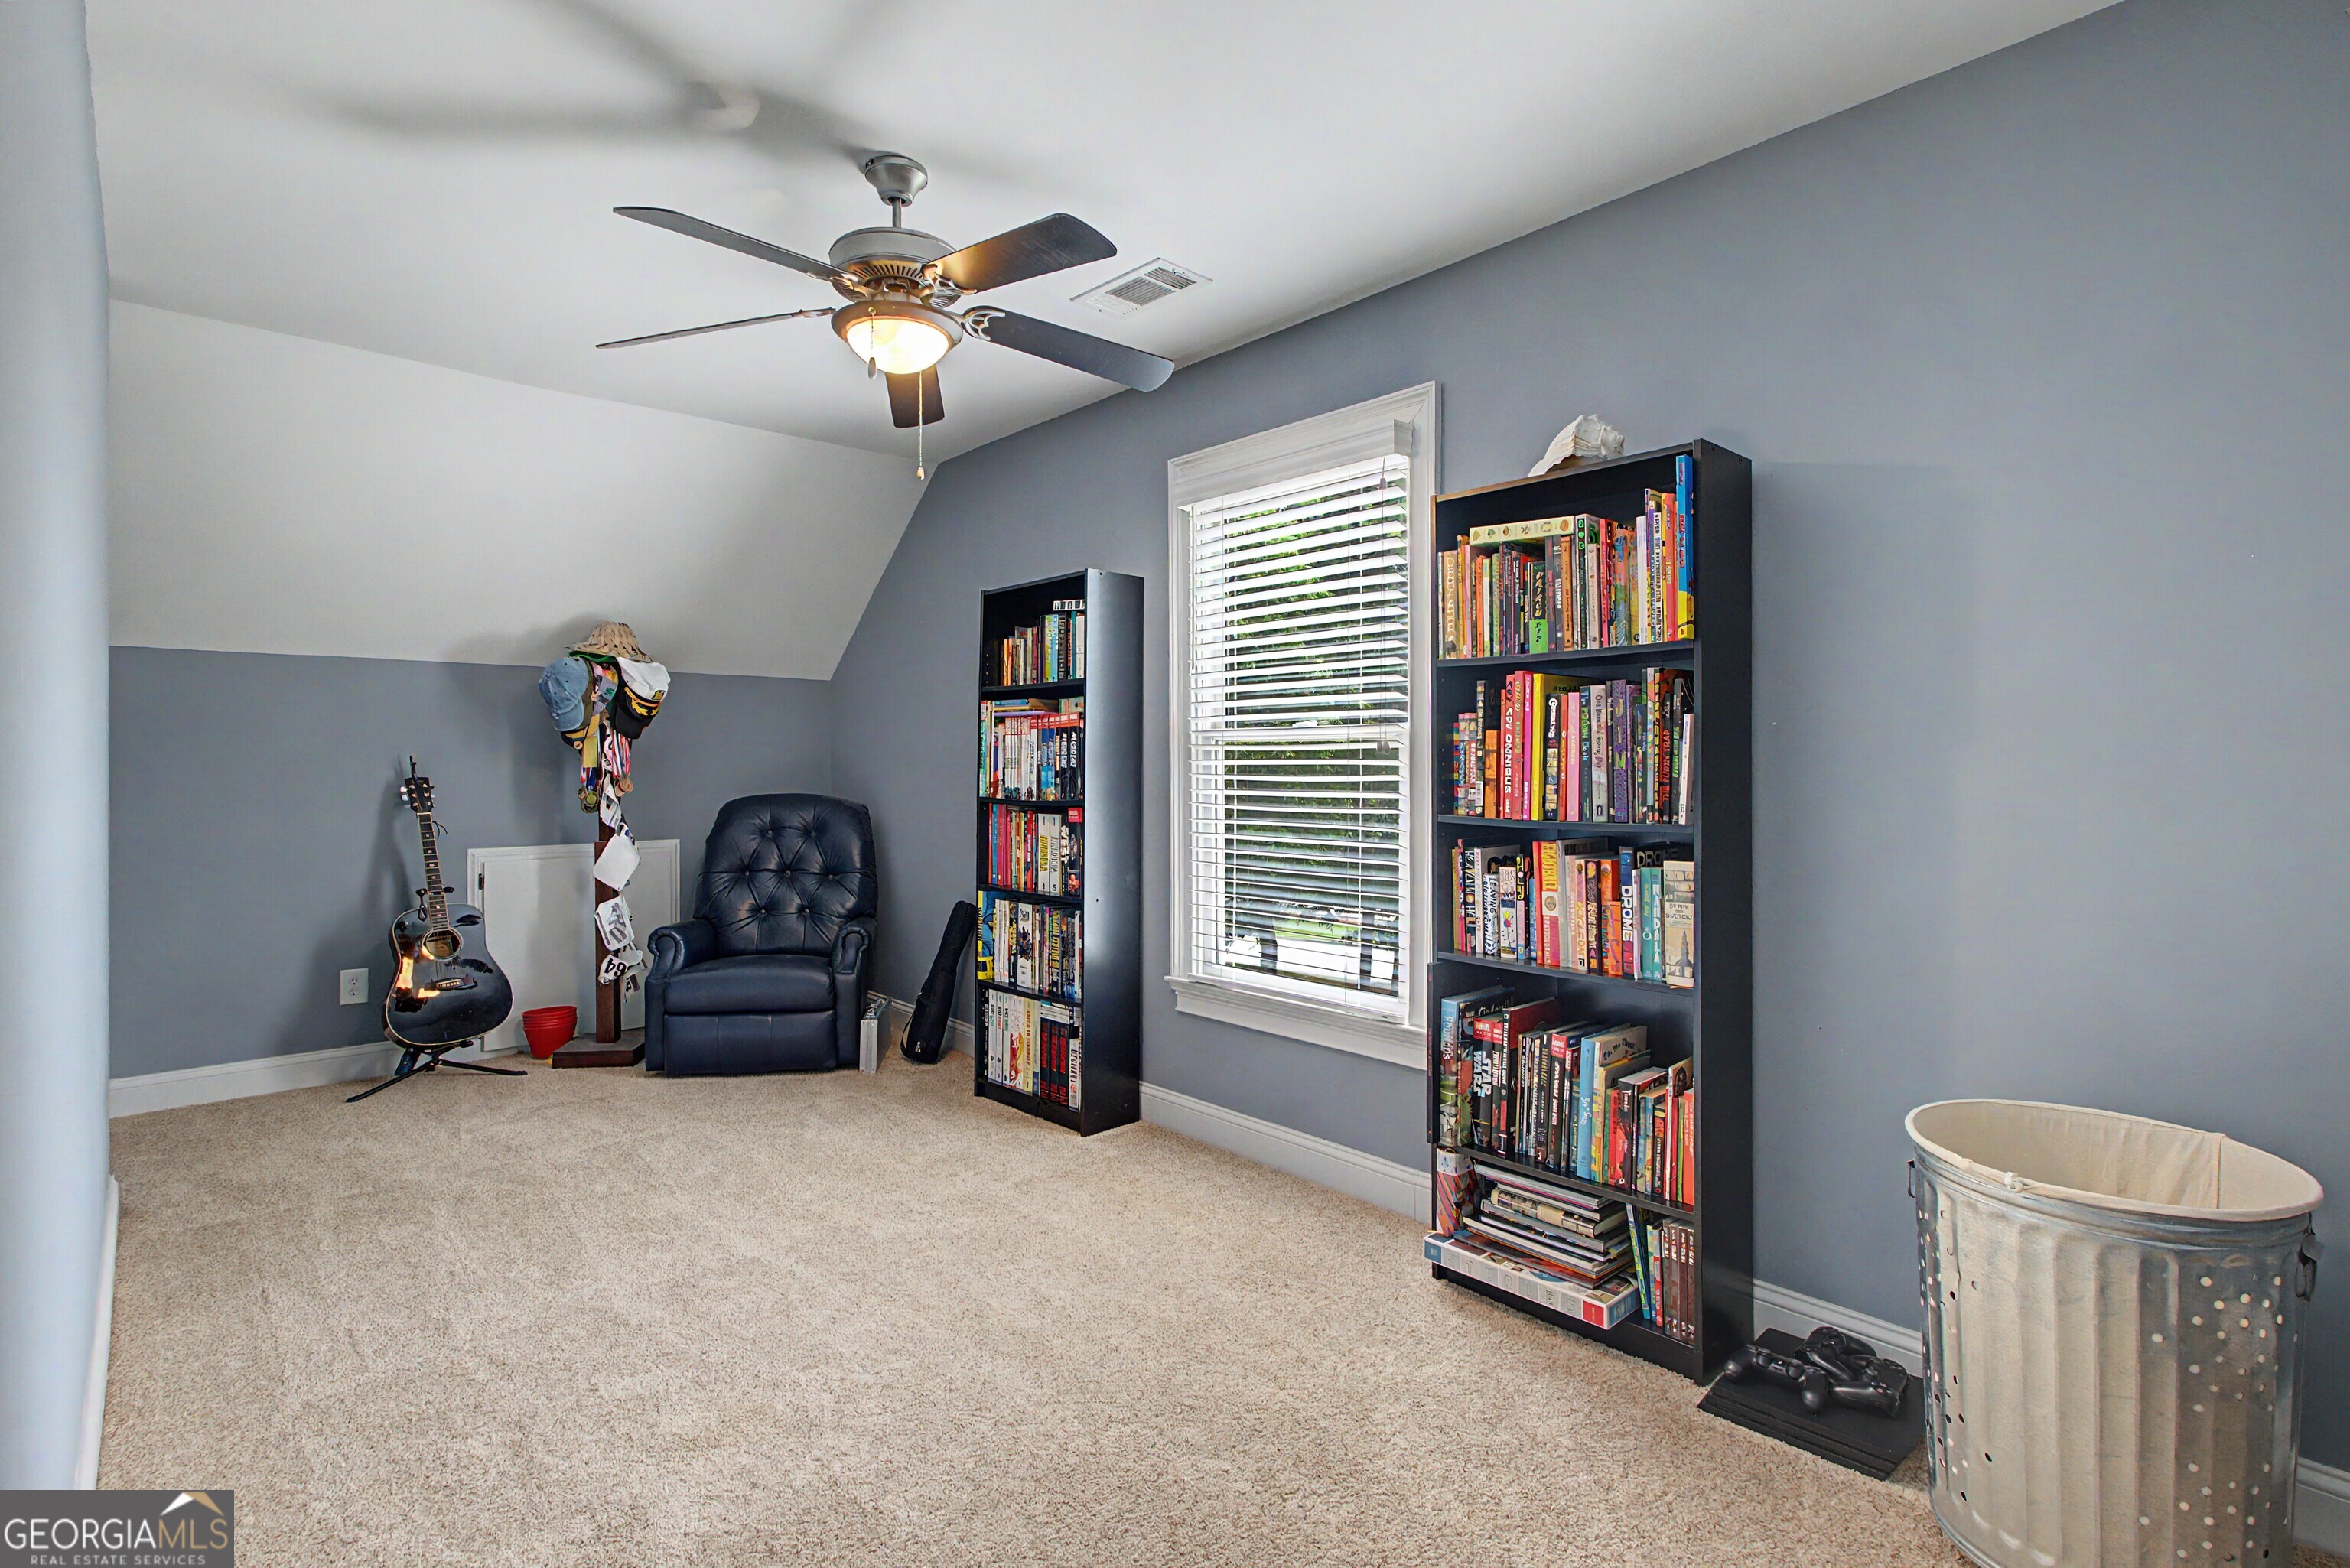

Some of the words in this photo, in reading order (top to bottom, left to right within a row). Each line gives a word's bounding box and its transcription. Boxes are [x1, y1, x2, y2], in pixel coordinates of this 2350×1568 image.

[1621, 885, 1633, 942] DROME
[1473, 1051, 1483, 1095] WARS
[1481, 1051, 1492, 1098] STAR
